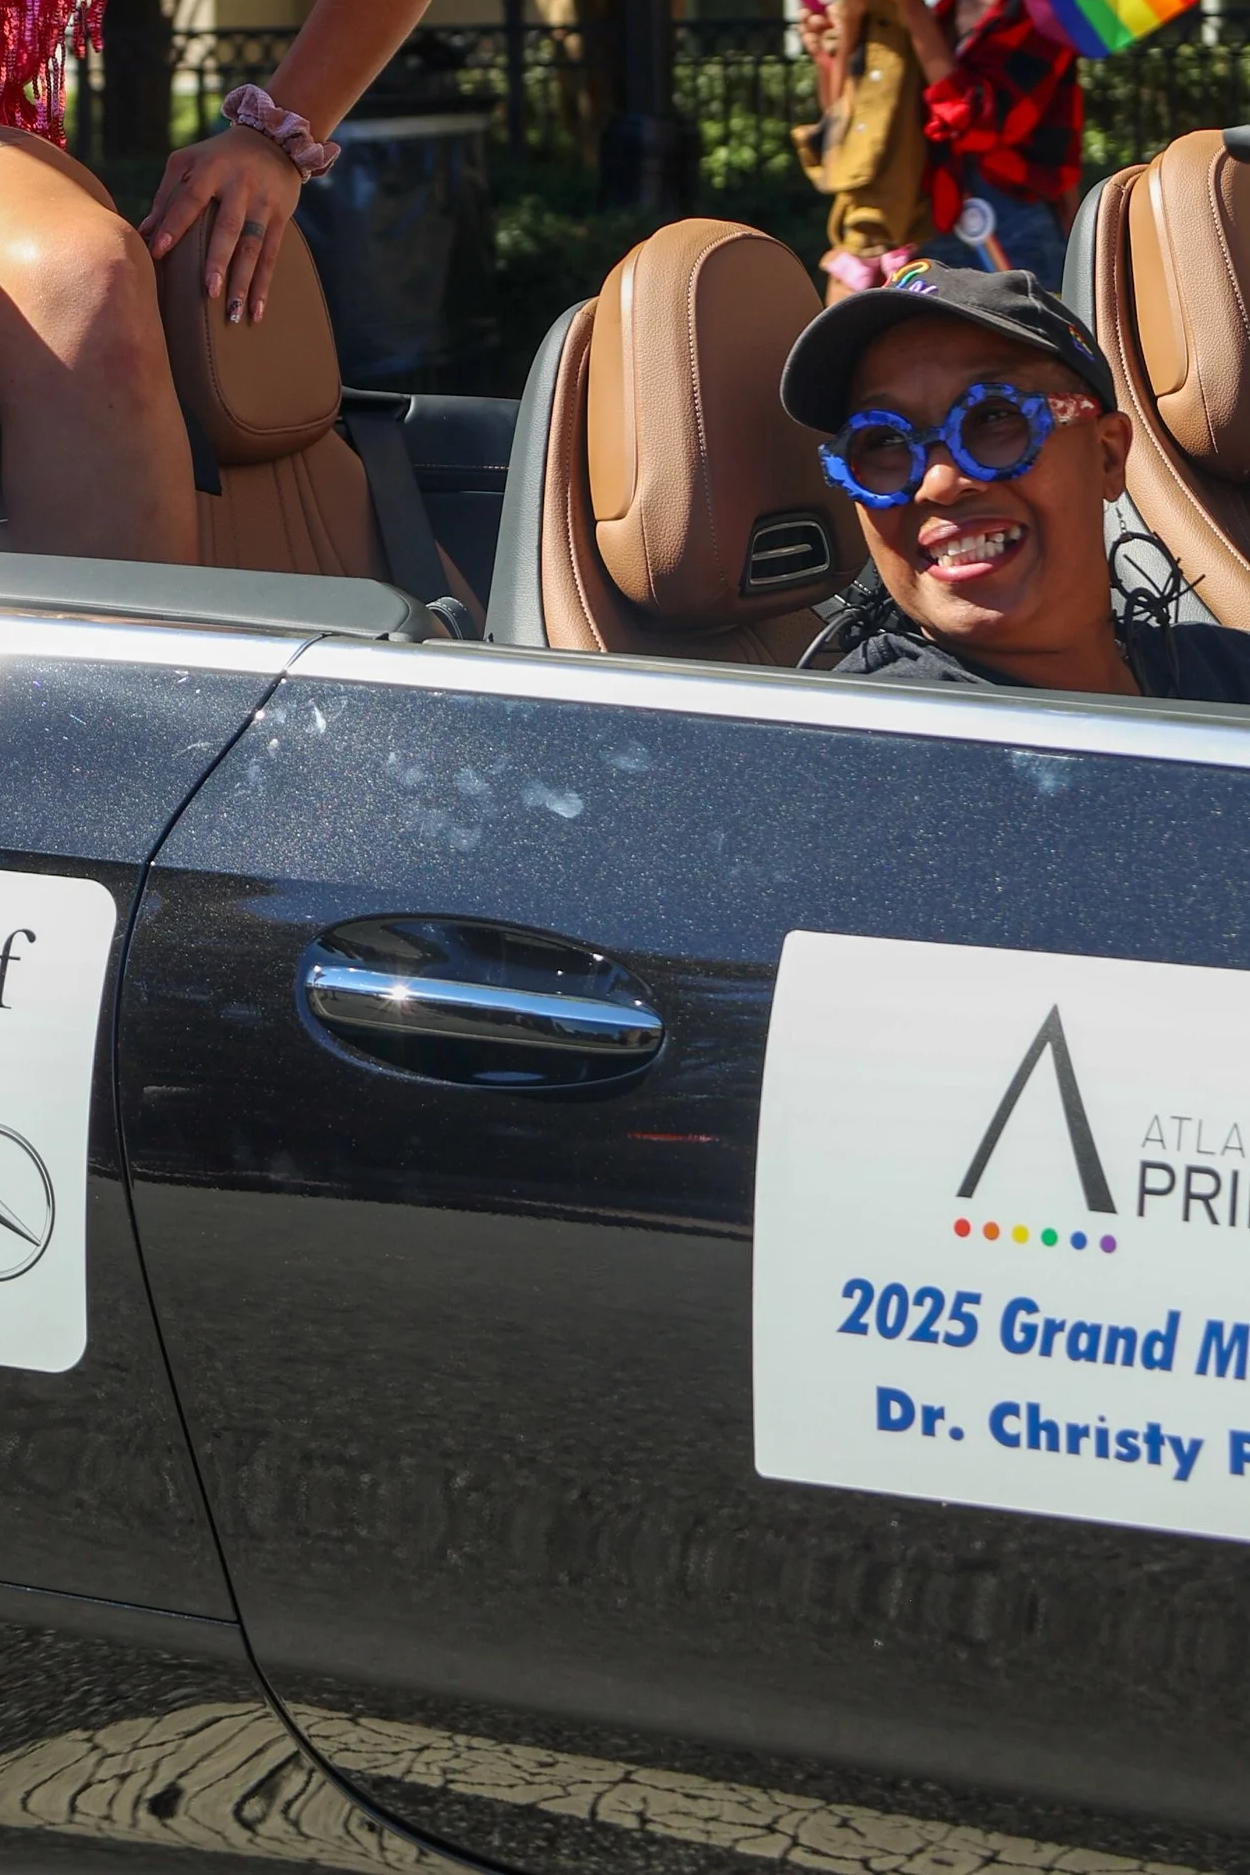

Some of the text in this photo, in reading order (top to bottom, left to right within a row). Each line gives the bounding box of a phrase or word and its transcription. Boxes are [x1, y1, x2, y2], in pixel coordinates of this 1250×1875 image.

[1139, 1114, 1247, 1160] ATLA
[1137, 1160, 1250, 1230] PRI
[836, 1277, 982, 1348] 2025
[1000, 1296, 1182, 1373] Grand
[876, 1386, 965, 1442] Dr.
[988, 1401, 1205, 1482] Christy
